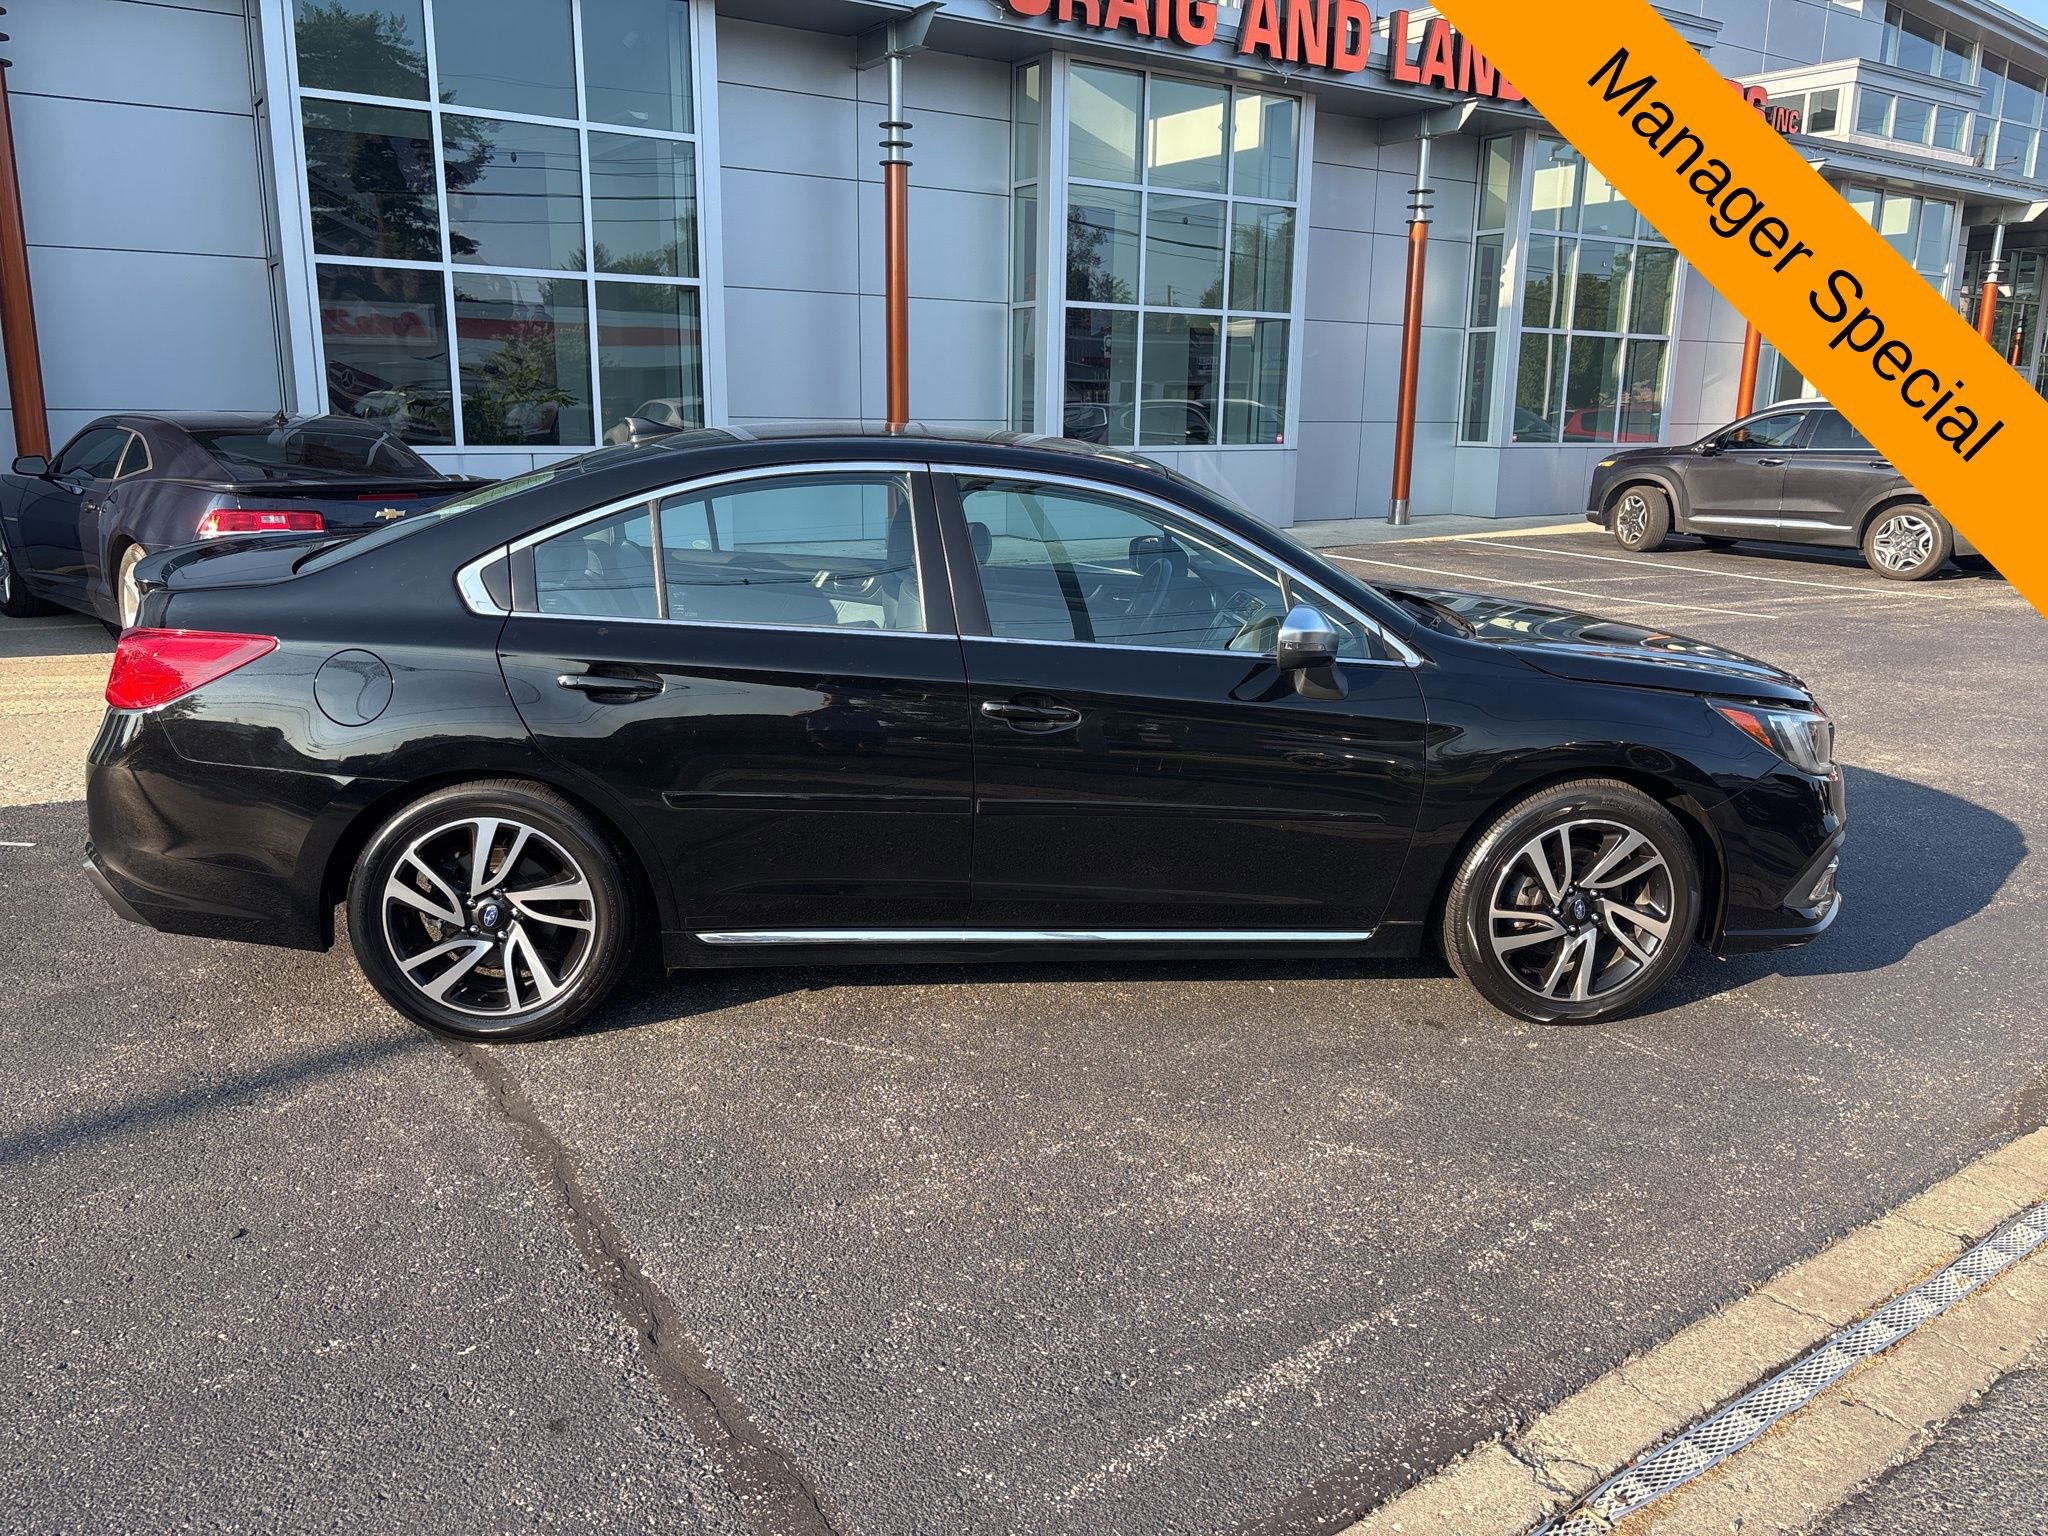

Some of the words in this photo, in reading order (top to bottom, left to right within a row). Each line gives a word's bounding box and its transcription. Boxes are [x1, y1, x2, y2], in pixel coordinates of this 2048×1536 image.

[1008, 0, 1217, 46] AIG
[1238, 0, 1371, 73] AND
[1769, 106, 1800, 134] INC
